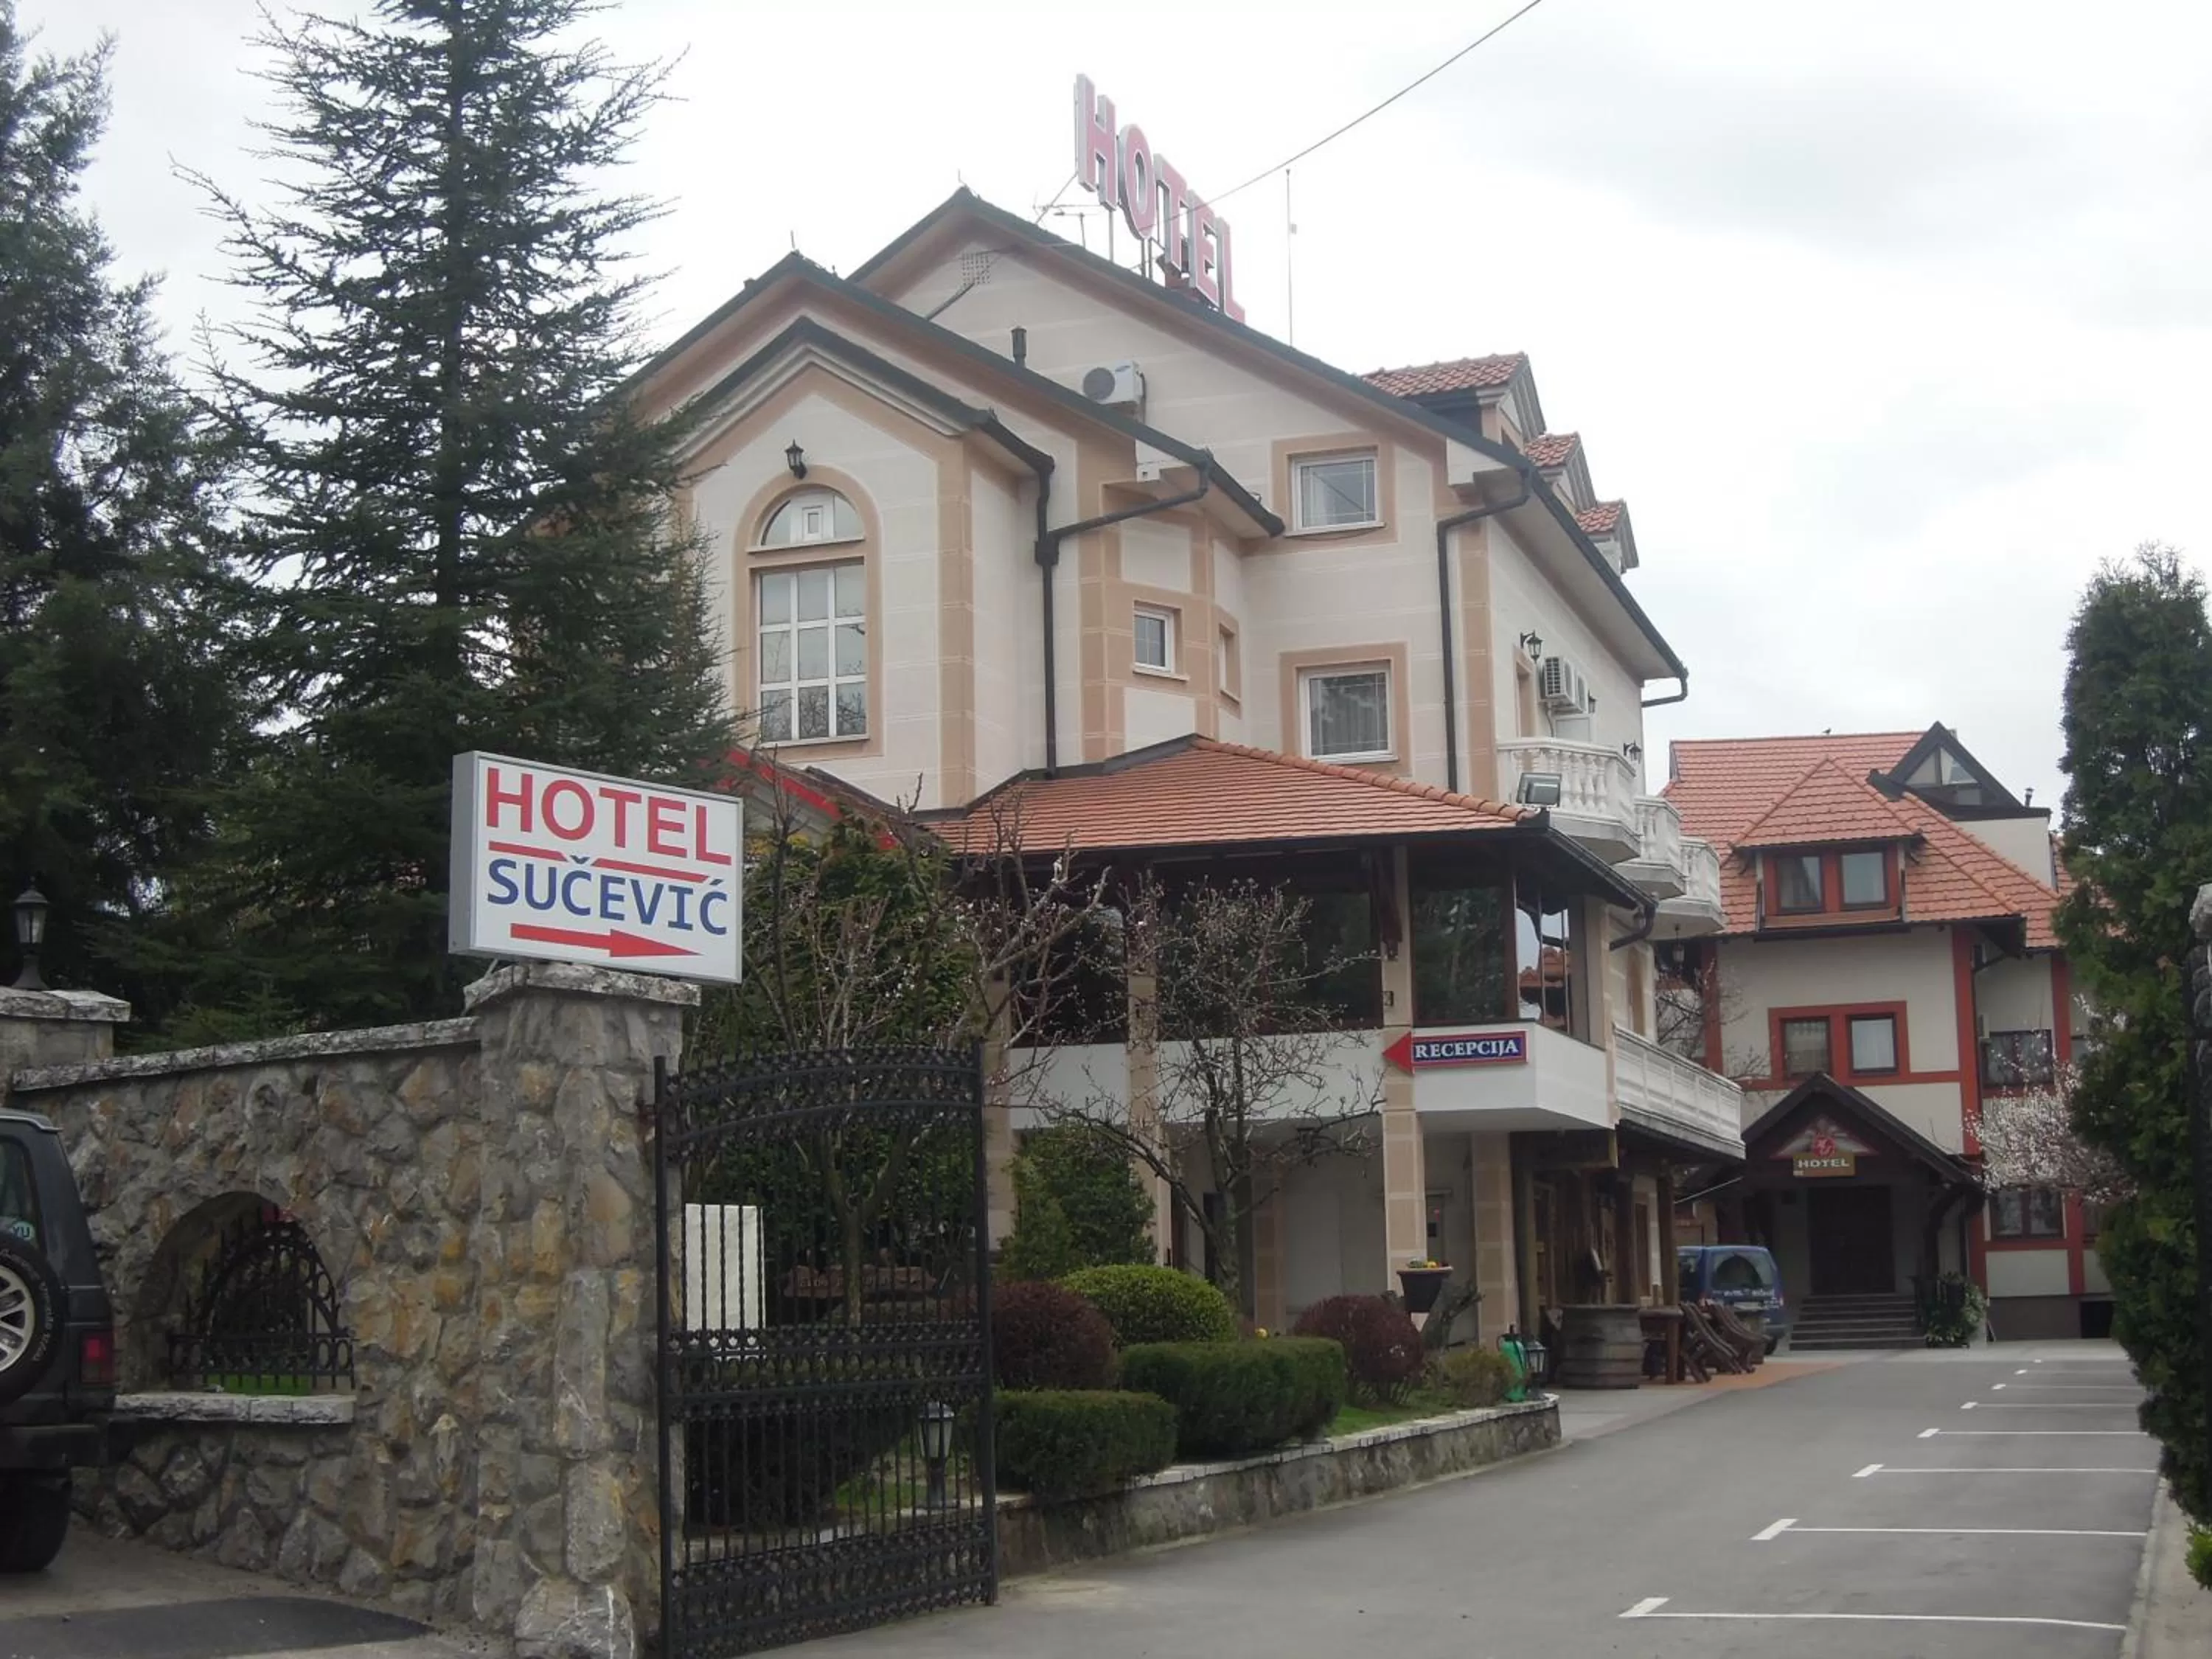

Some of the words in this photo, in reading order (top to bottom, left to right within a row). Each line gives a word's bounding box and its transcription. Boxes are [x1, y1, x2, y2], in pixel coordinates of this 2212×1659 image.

[1074, 73, 1245, 324] HOTEL
[486, 766, 731, 866] HOTEL
[487, 855, 728, 936] SUČEVIĆ
[1415, 1039, 1519, 1059] RECEPCIJA
[1798, 1158, 1850, 1169] HOTEL
